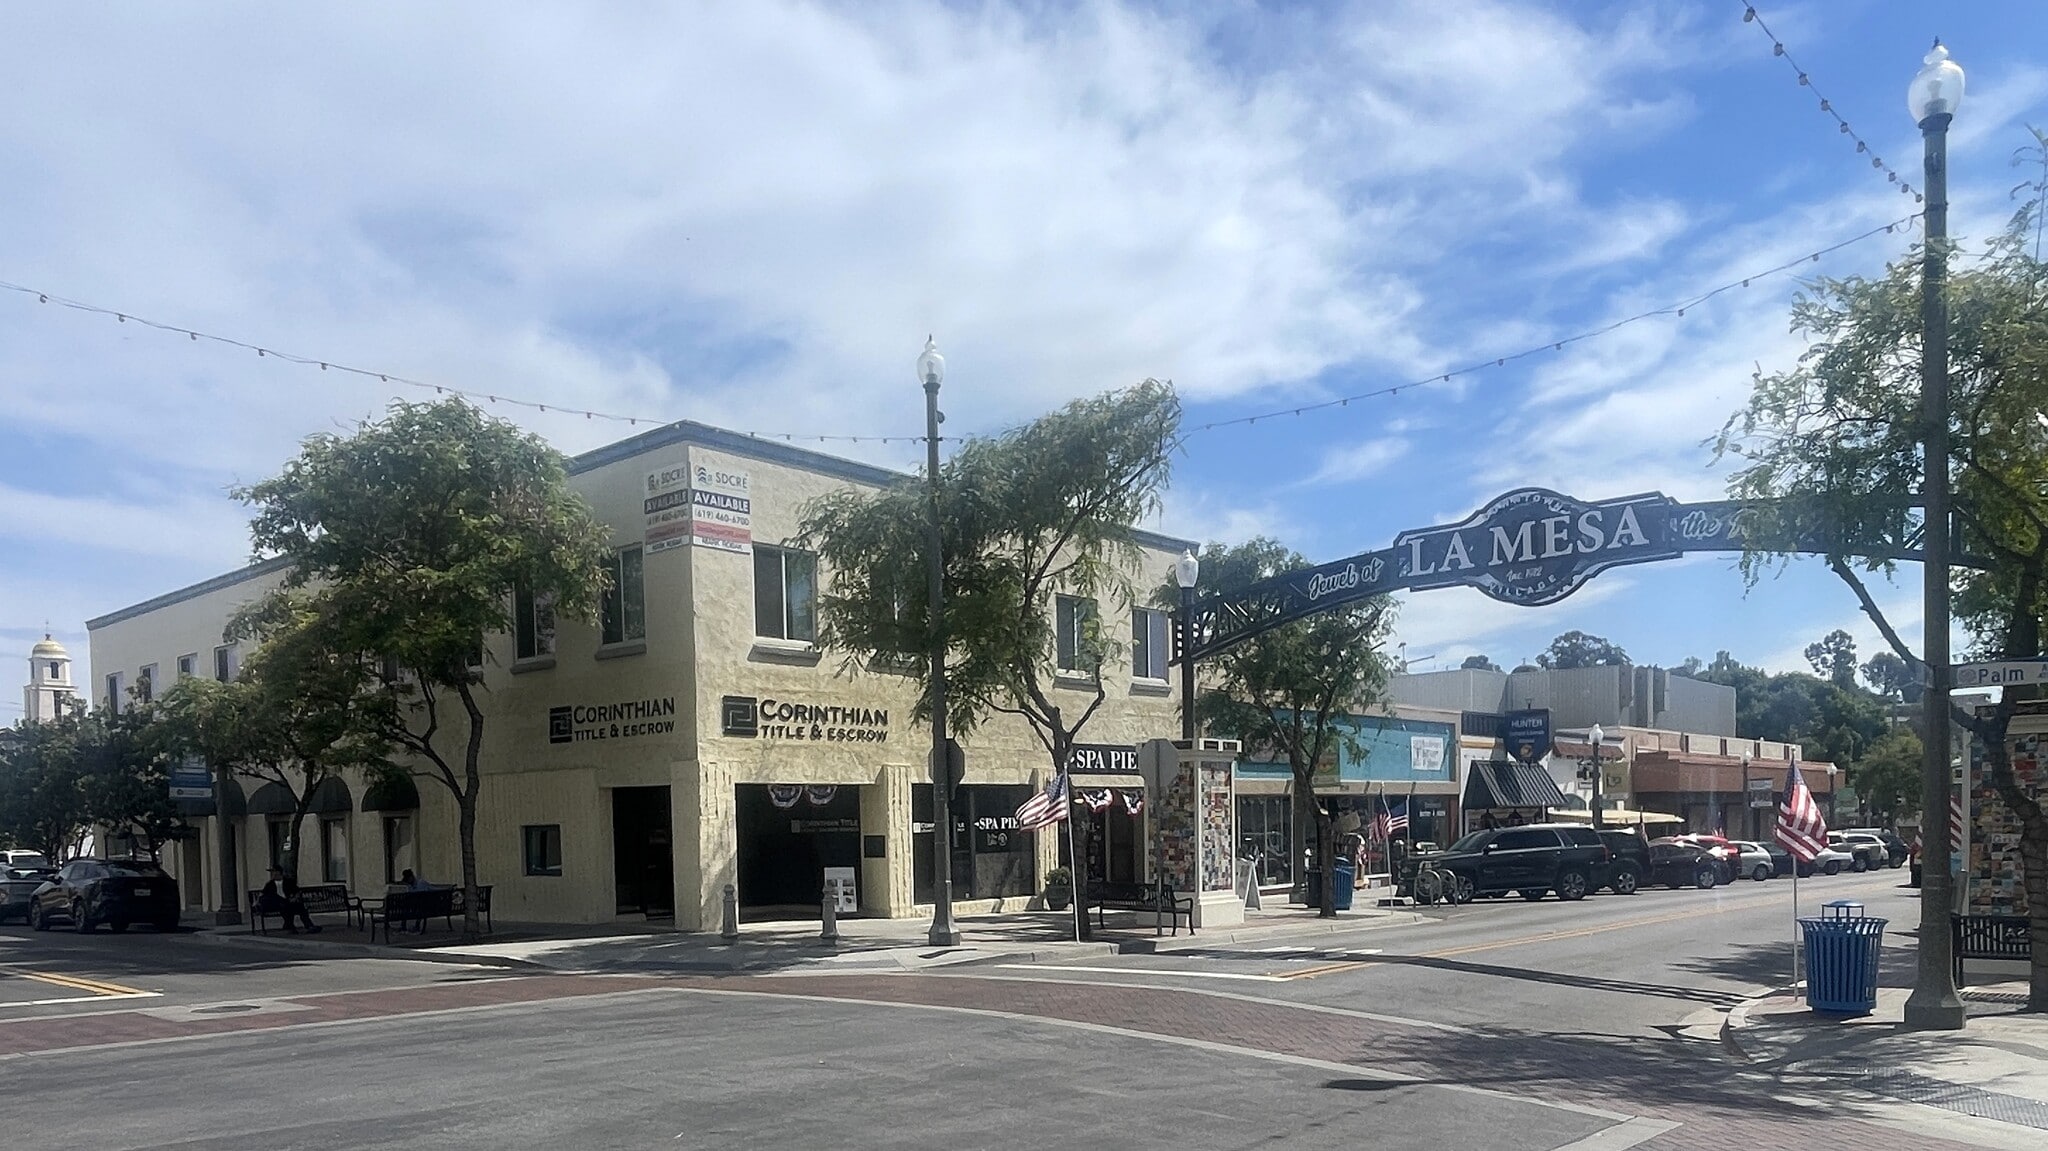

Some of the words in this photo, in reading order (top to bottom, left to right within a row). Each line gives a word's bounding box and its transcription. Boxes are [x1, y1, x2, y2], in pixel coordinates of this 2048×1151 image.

[715, 472, 748, 489] SDCRE
[647, 491, 687, 512] AVAILABLE
[694, 491, 749, 513] AVAILABLE
[694, 509, 714, 520] (619)
[715, 512, 750, 526] 460-6700
[1681, 510, 1721, 539] the
[1408, 531, 1475, 577] LA
[1488, 505, 1650, 566] MESA
[1308, 563, 1359, 600] Jewel
[1361, 557, 1385, 582] of
[1488, 574, 1557, 597] VILLAGE
[1978, 667, 2024, 683] Palm
[573, 697, 676, 724] CORINTHIAN
[760, 699, 888, 726] CORINTHIAN
[574, 727, 606, 741] TITLE
[609, 723, 619, 738] &
[623, 721, 675, 737] ESCROW
[1511, 718, 1543, 728] HUNTER
[760, 725, 805, 740] TITLE
[809, 724, 822, 741] &
[827, 727, 888, 743] ESCROW
[1076, 749, 1105, 769] SPA
[1110, 750, 1138, 769] PIE
[979, 817, 999, 830] SPA
[1000, 817, 1020, 829] PIE
